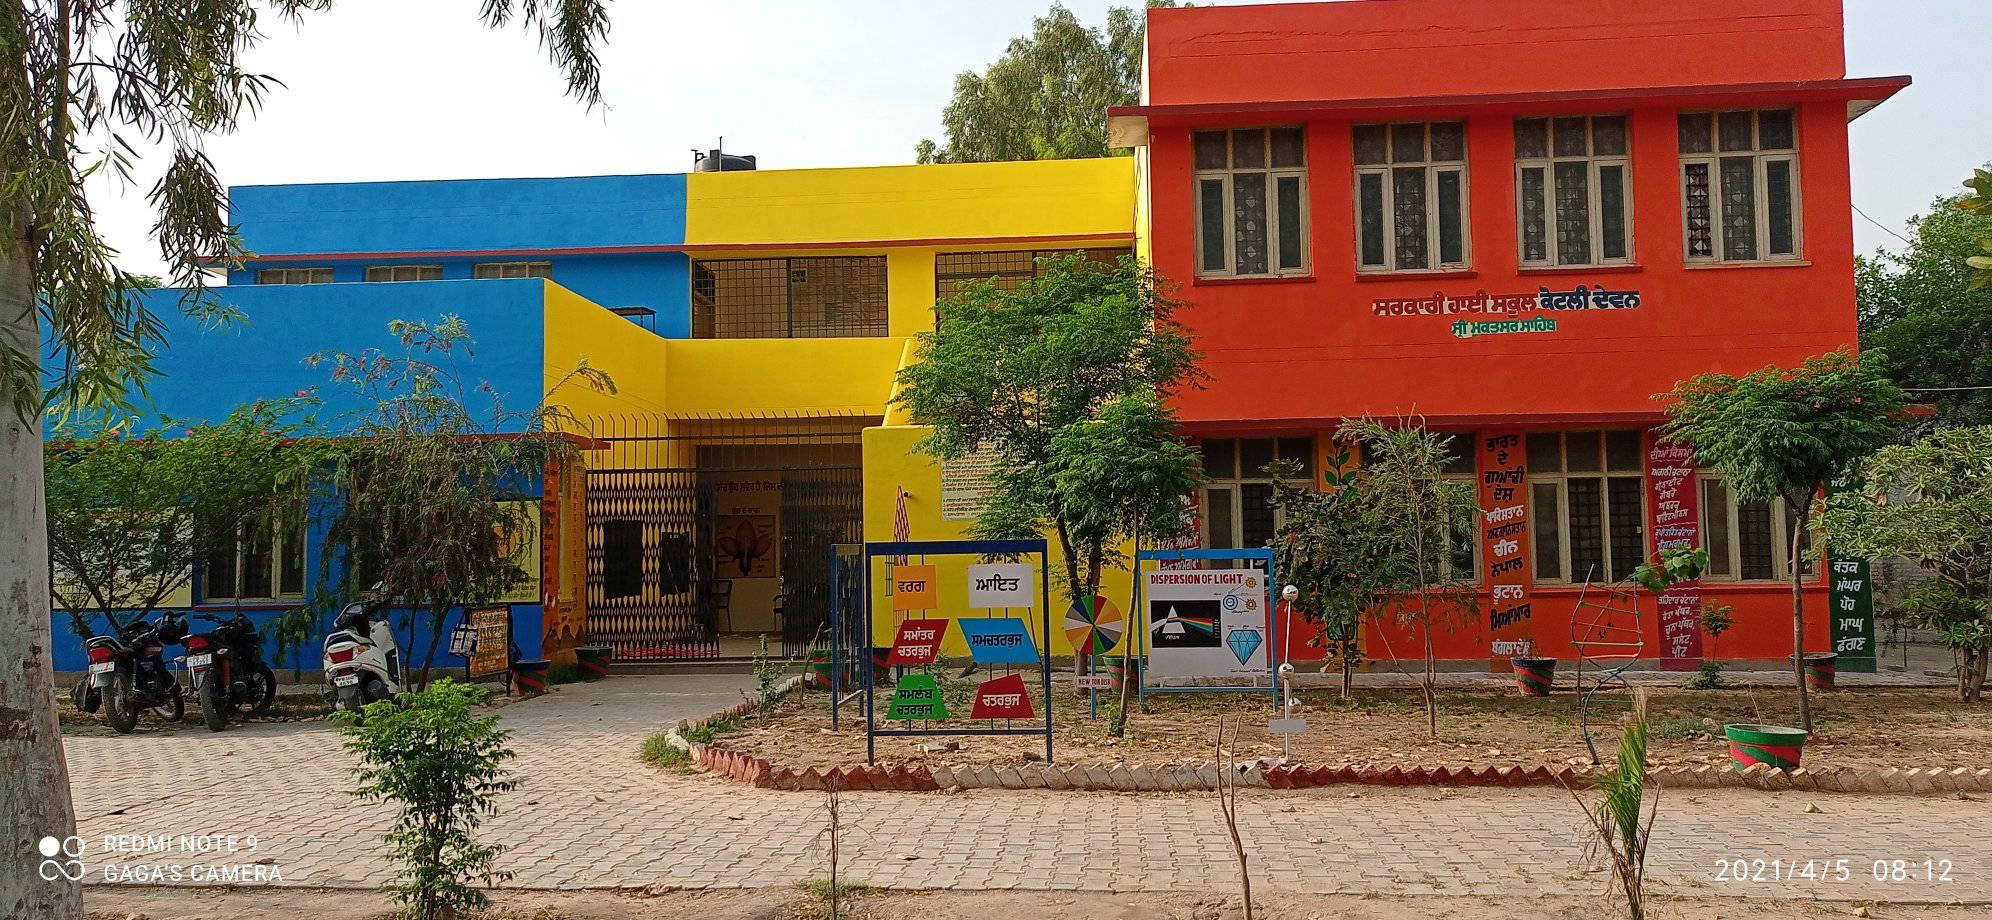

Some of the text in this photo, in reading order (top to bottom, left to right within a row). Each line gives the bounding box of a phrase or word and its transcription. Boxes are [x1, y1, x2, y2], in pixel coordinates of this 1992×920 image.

[1373, 291, 1443, 315] ਸਰਕਾਰੀ
[1444, 289, 1487, 313] ਹਾਈ
[1489, 293, 1537, 318] ਸਕੂਲ
[1520, 316, 1557, 332] ਸਾਹਿਬ
[1486, 434, 1521, 451] ਭਾਰਤ
[1496, 450, 1509, 465] ਦੇ
[1486, 504, 1525, 523] ਪਾਕਿਸਤਾਨ
[1493, 538, 1519, 557] ਚੀਨ
[1490, 557, 1523, 578] ਨੇਪਾਲ
[1834, 558, 1859, 574] ਕੱਤਕ
[897, 580, 926, 593] ਵਰਗ
[975, 574, 1021, 592] ਆਇਤ
[1150, 573, 1244, 585] DISPERSION OF LIGHT
[1837, 577, 1863, 592] ਮੱਘਰ
[1493, 585, 1524, 605] ਭੂਟਾਨ
[1840, 618, 1865, 632] ਮਾਘ
[903, 626, 936, 641] ਸਮਾਂਤਰ
[971, 633, 1024, 648] ਸਮਚਤਰਭੁਜ
[897, 644, 933, 659] ਚਤਰਭੁਜ
[1837, 636, 1867, 652] ਫੱਗਣ
[899, 686, 933, 700] ਸਮਲੰਬ
[982, 694, 1022, 709] ਚਤਰਭੁਜ
[896, 704, 934, 716] ਚਤਰਭੁਜ
